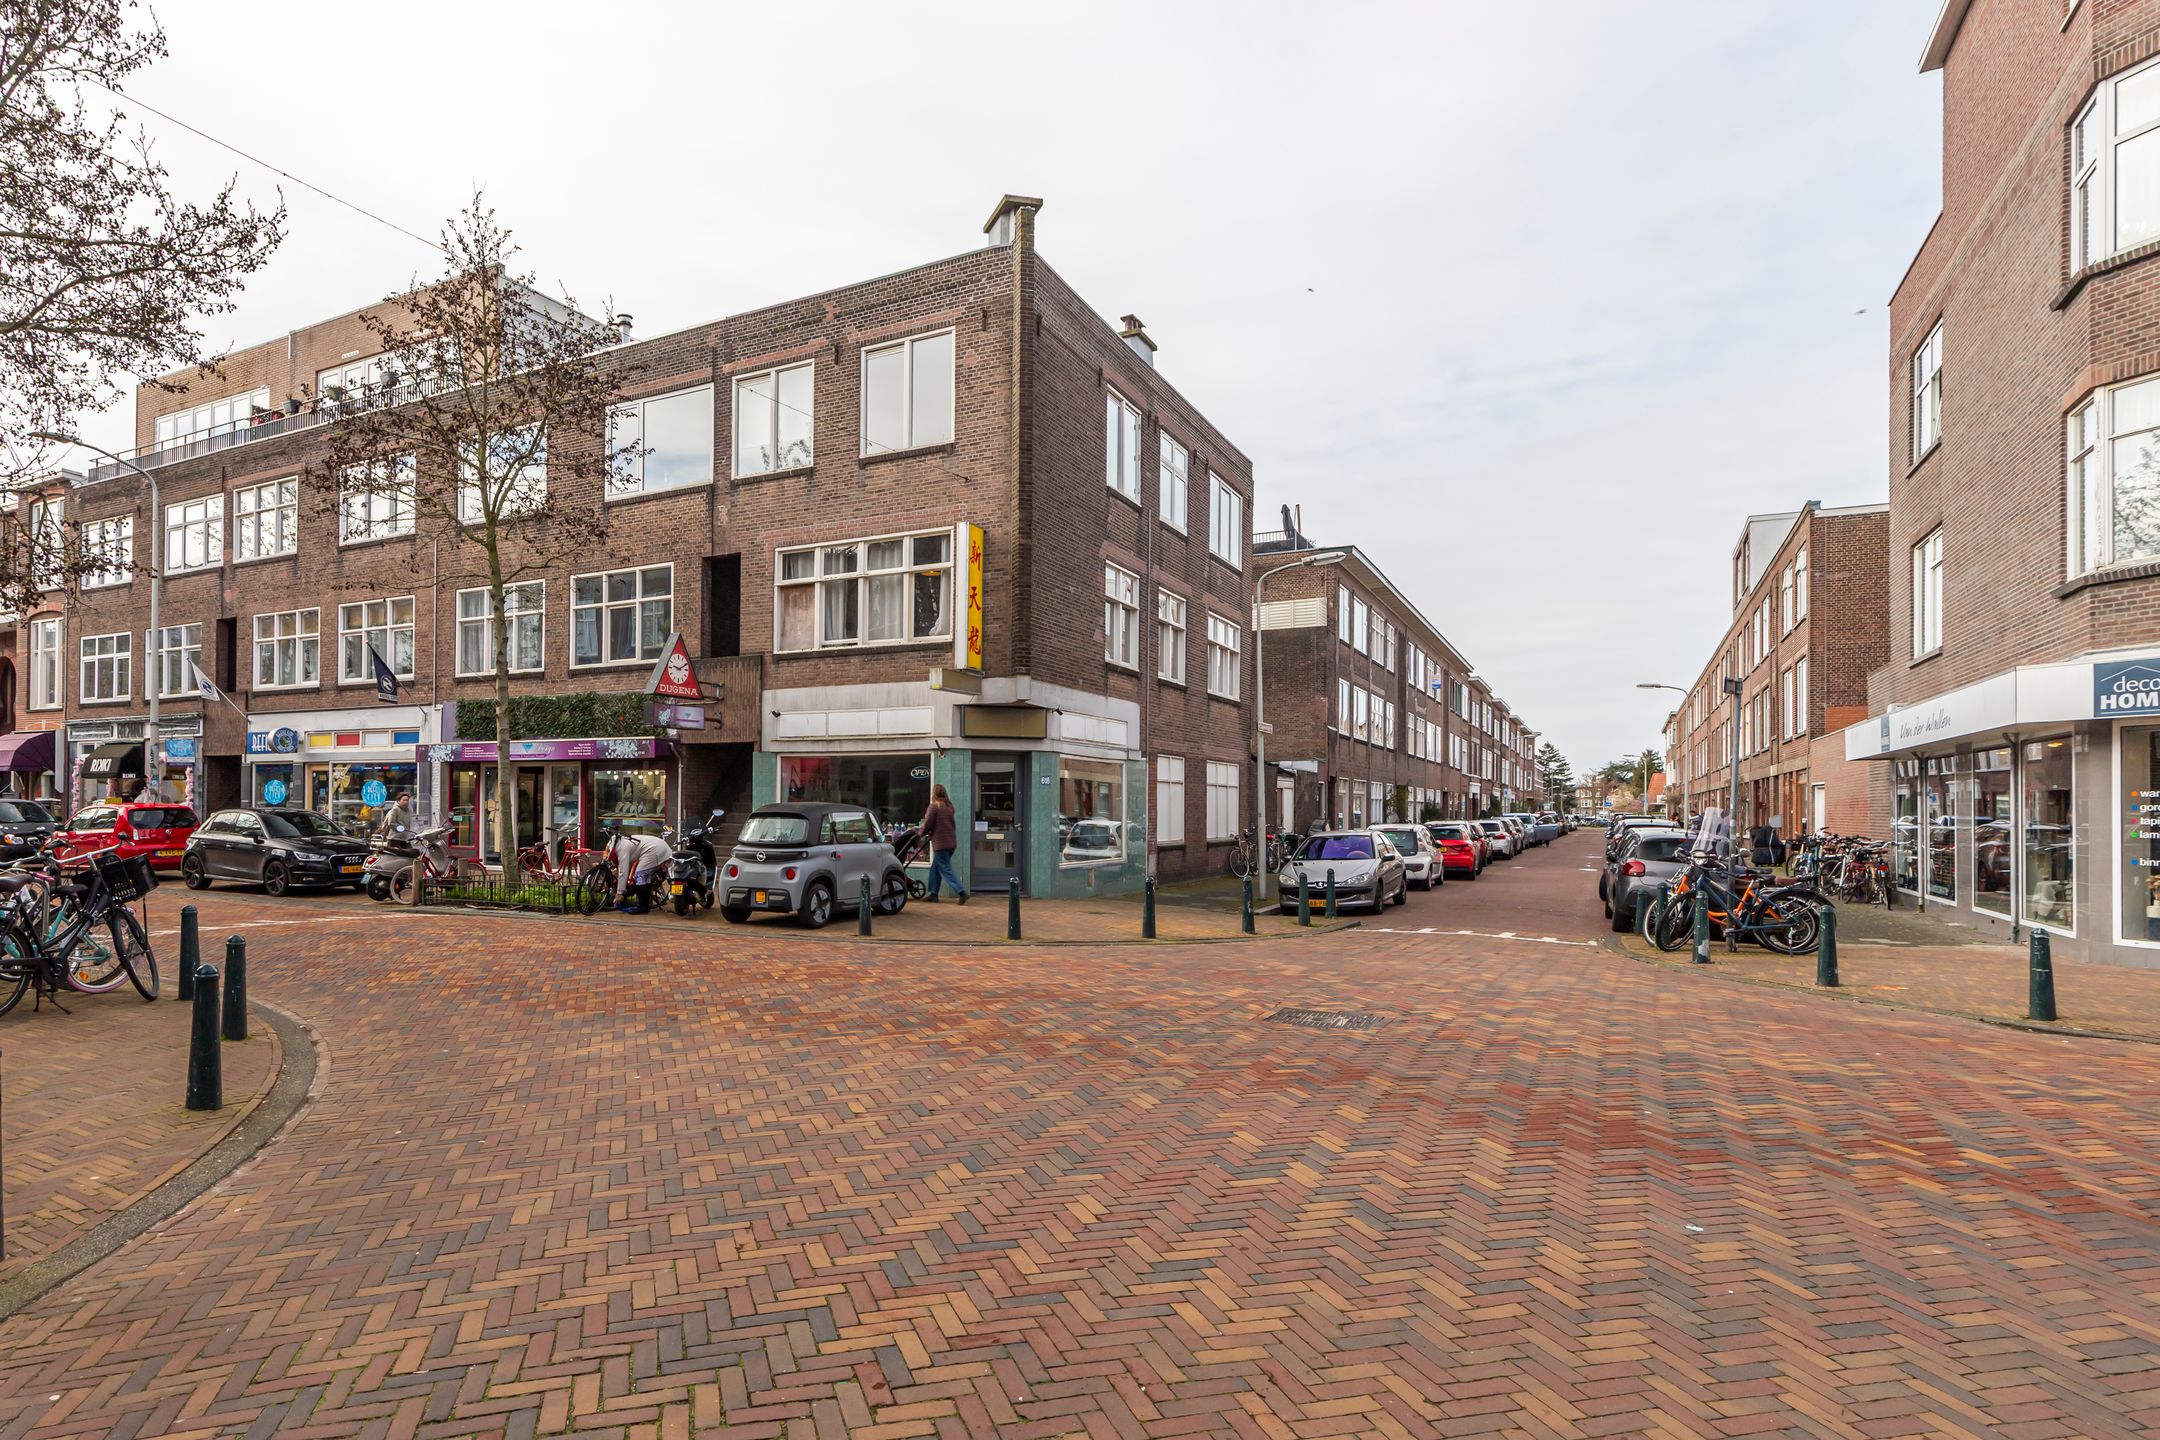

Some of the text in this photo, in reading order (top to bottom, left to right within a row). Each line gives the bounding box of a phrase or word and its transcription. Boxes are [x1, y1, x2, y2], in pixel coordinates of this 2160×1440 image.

[659, 683, 698, 696] DUGENA
[2113, 675, 2160, 693] deco
[2140, 830, 2160, 839] lam
